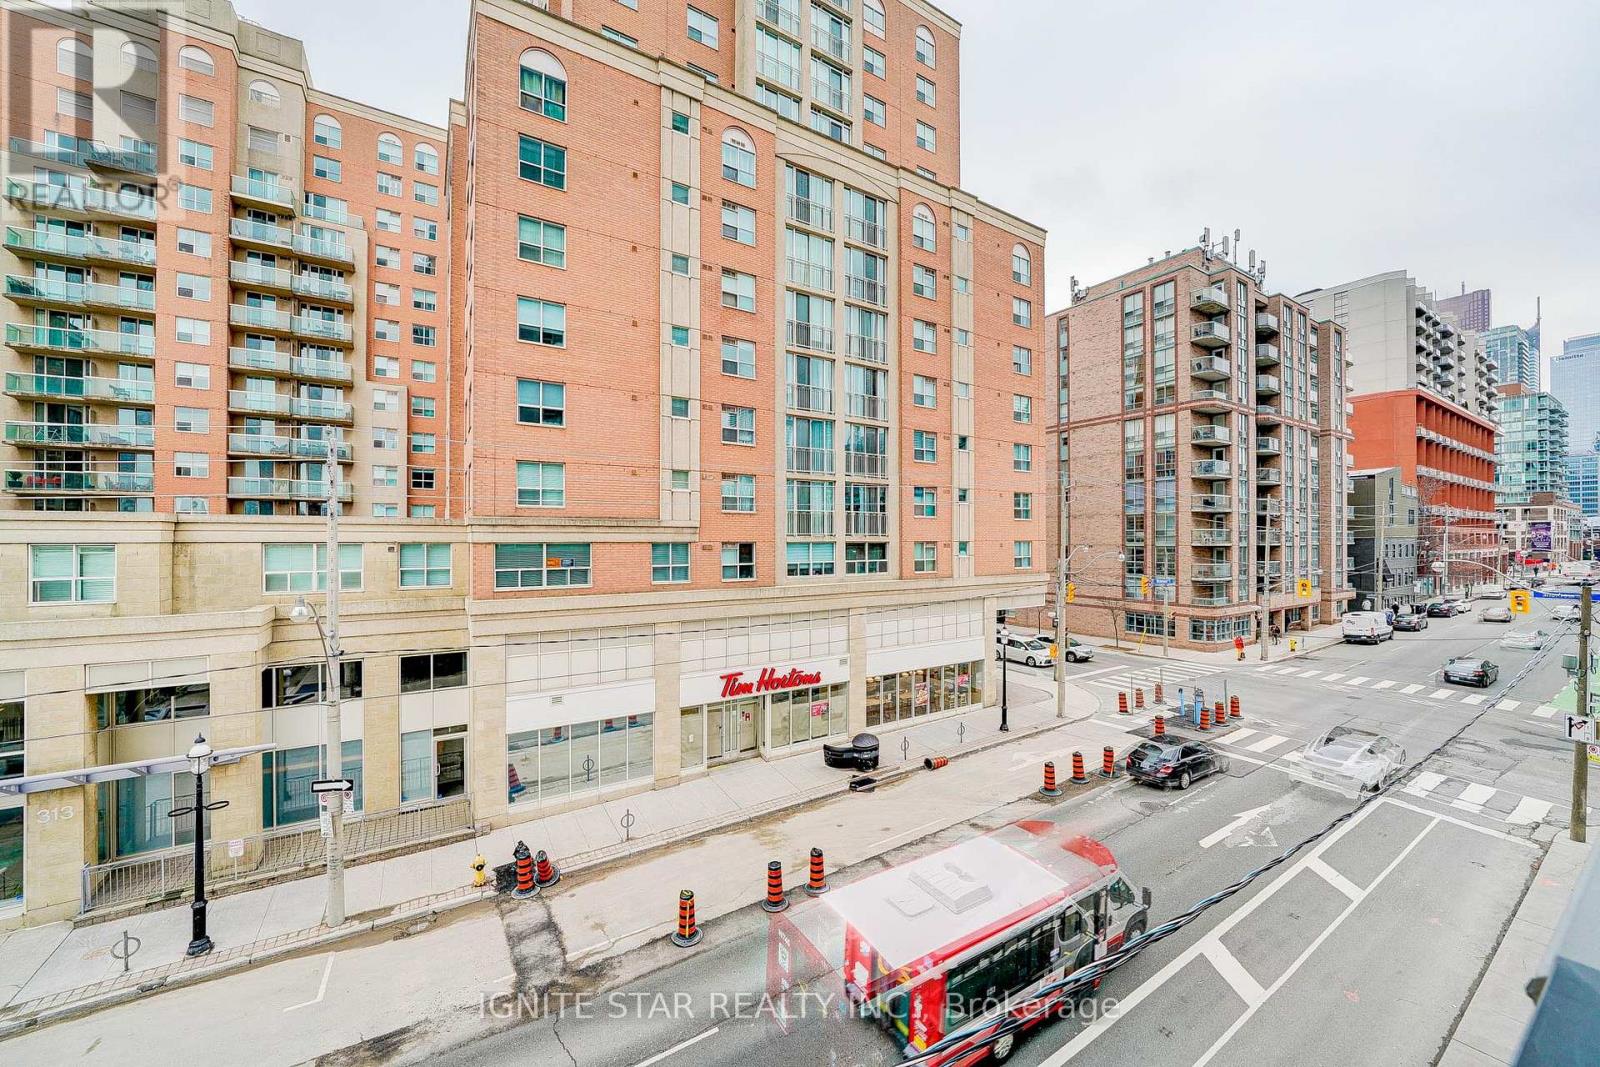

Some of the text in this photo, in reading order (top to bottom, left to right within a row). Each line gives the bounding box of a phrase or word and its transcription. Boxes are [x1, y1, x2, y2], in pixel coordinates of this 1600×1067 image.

[720, 667, 821, 698] Tim Hortons
[37, 805, 74, 824] 313
